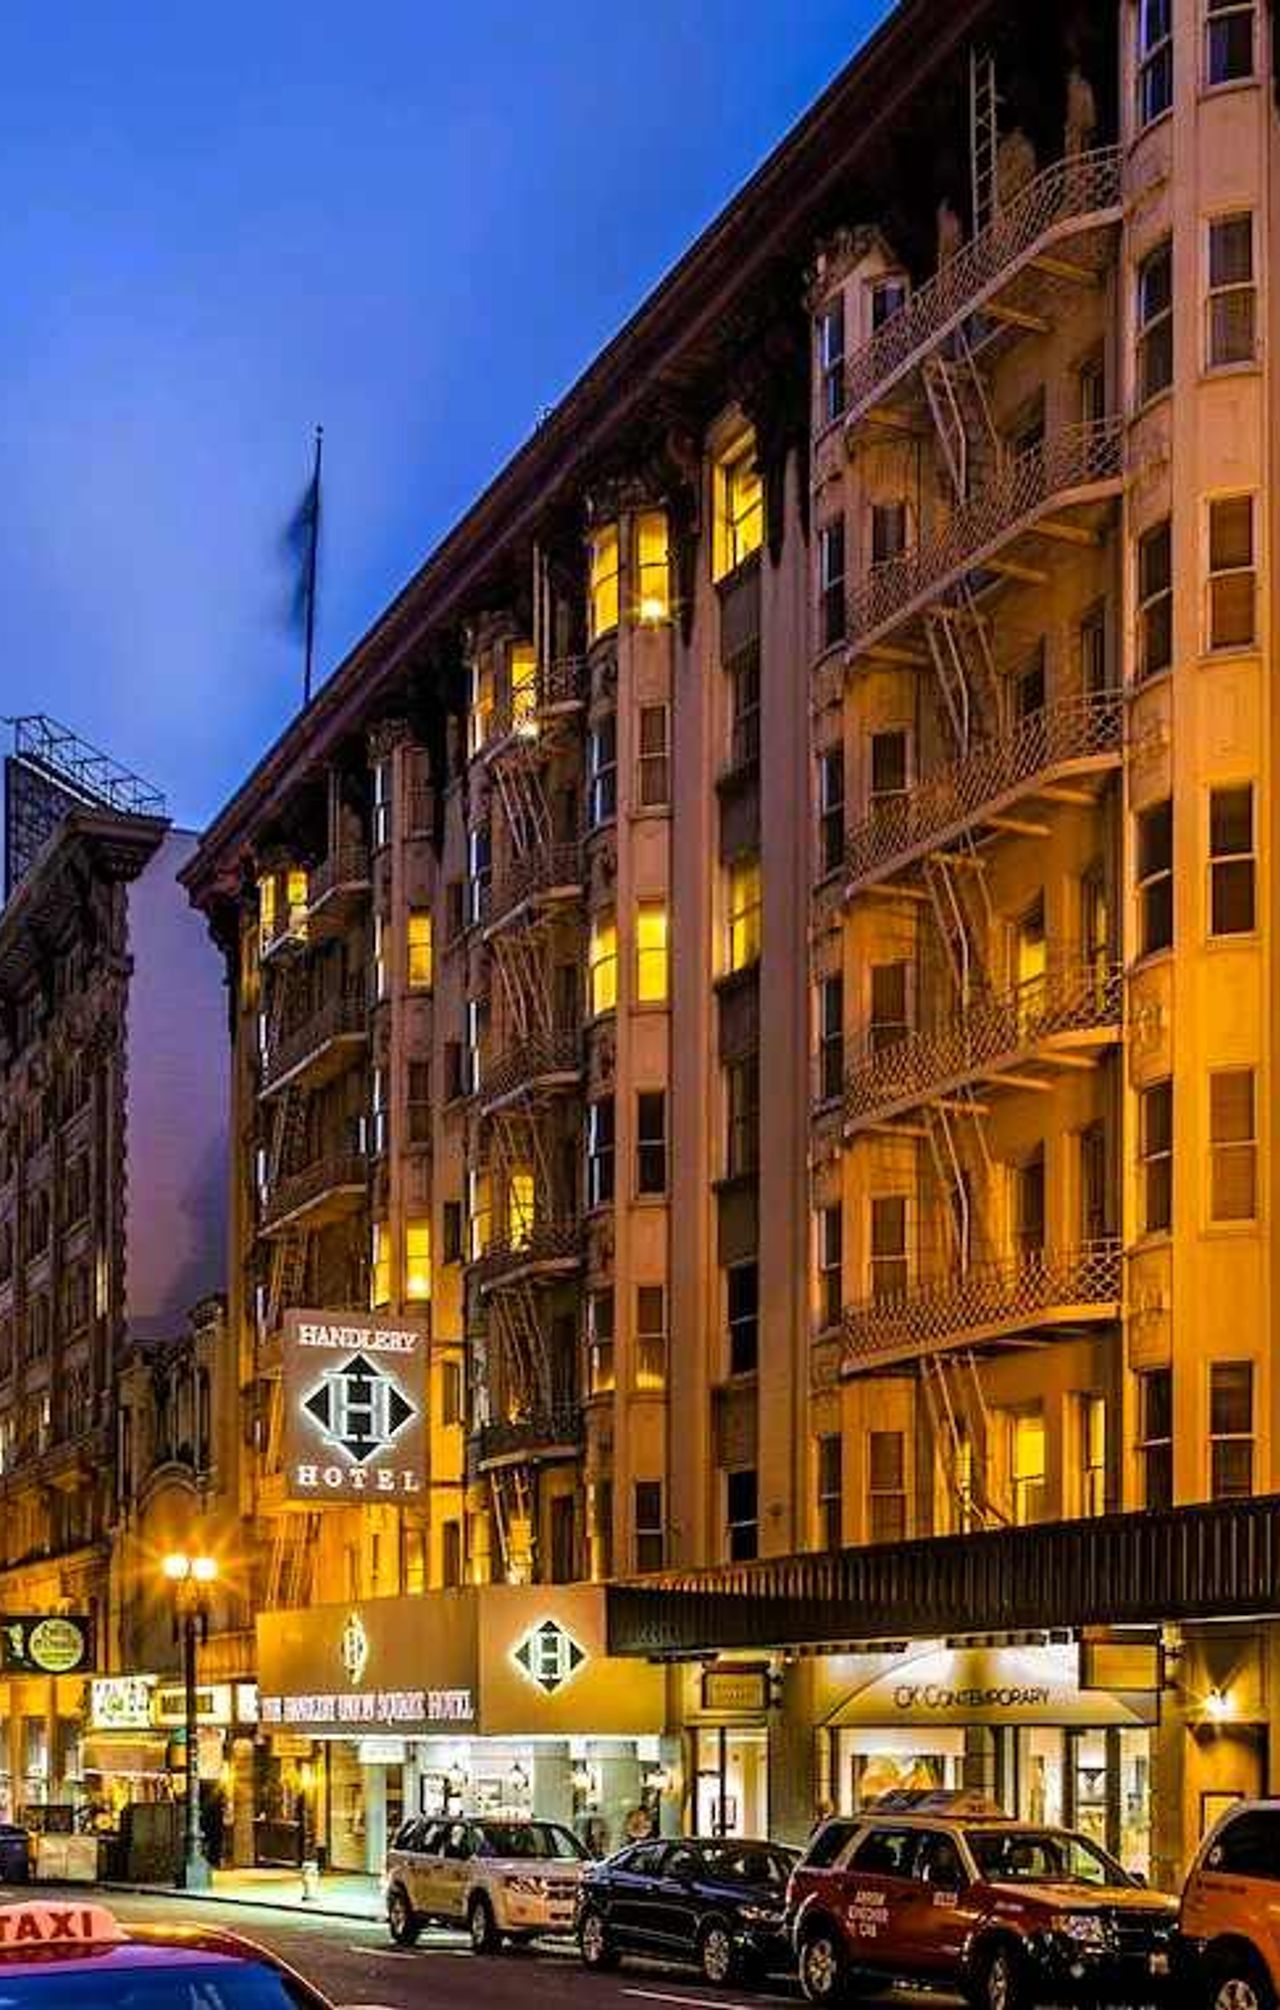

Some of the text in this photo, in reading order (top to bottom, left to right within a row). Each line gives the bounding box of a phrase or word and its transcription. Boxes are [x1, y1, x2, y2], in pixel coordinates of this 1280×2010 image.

[298, 1324, 419, 1351] HANDLERY
[321, 1368, 398, 1448] H
[298, 1464, 420, 1491] HOTEL
[0, 1910, 92, 1942] TAXI
